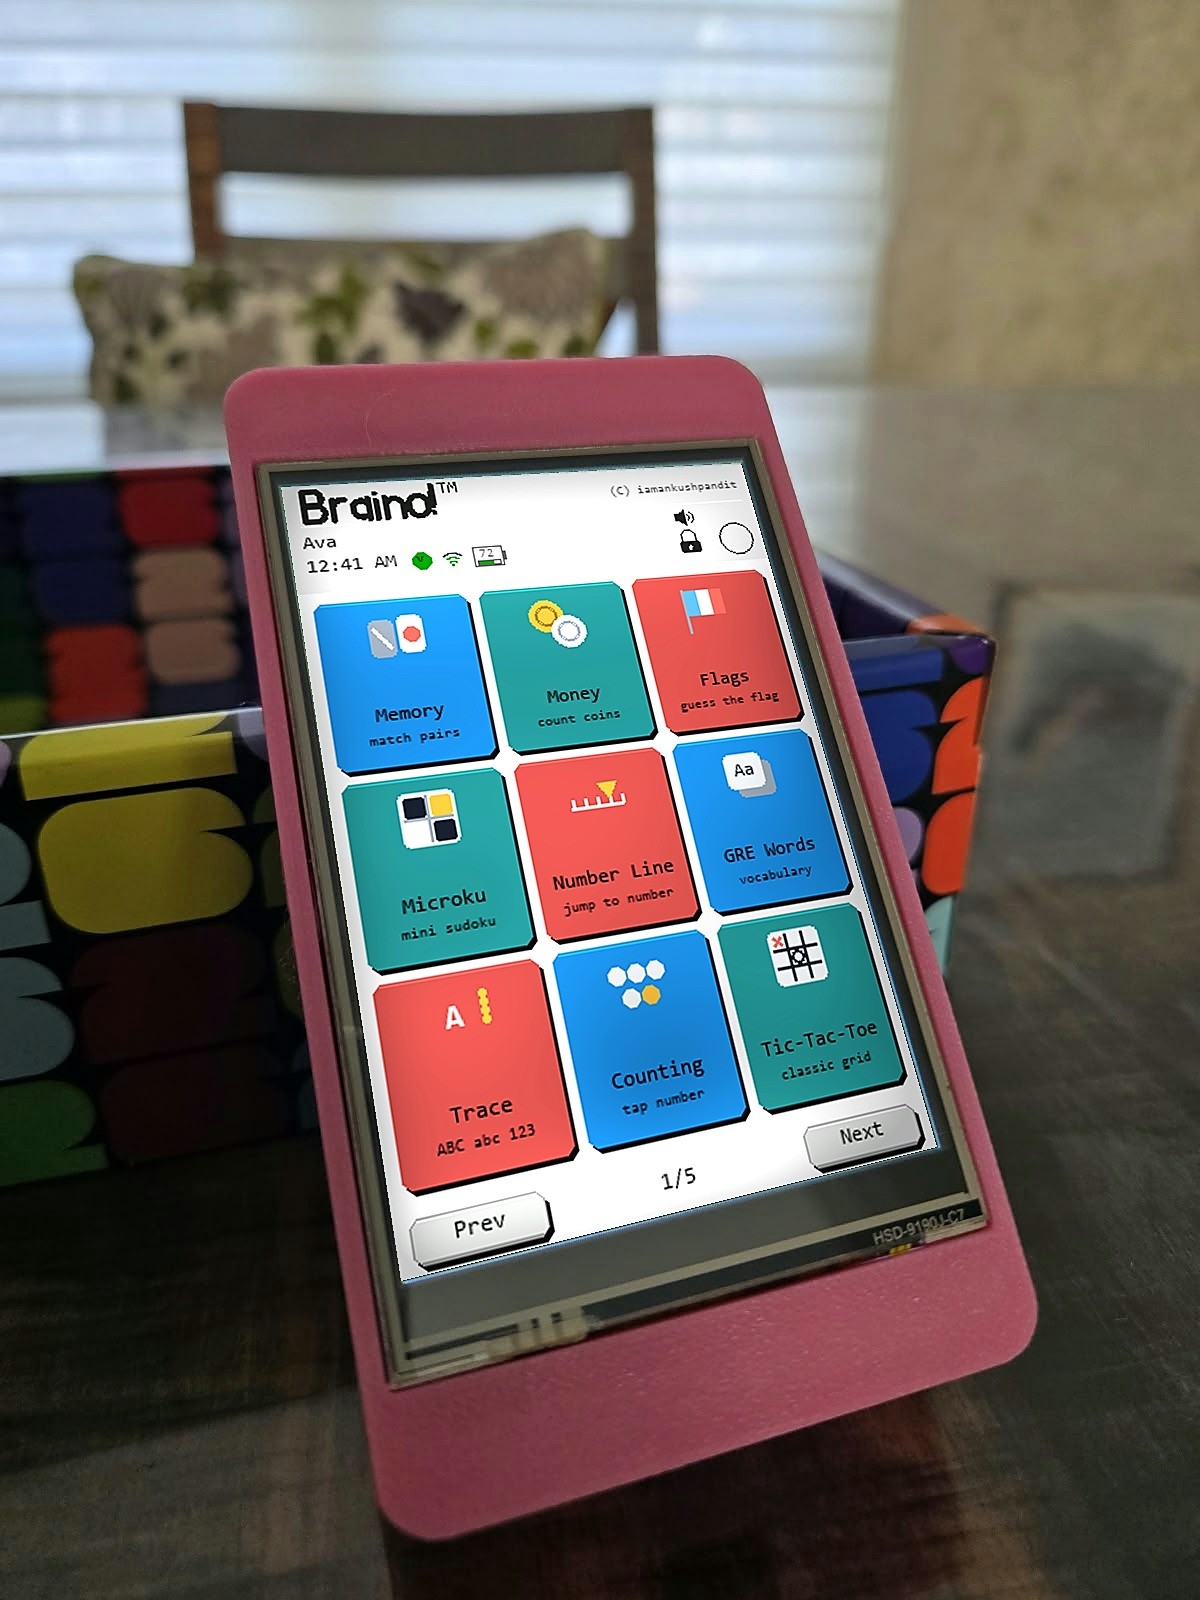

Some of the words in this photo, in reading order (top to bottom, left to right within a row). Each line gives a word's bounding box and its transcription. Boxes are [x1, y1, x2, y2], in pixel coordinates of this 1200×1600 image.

[610, 484, 630, 498] (C)
[637, 480, 738, 494] iamankushpandit
[303, 537, 337, 550] Ava
[479, 548, 495, 558] 72
[306, 557, 364, 574] 12:41
[374, 555, 398, 569] AM
[700, 671, 750, 687] Flags
[547, 687, 601, 704] Money
[680, 698, 716, 713] guess
[722, 695, 745, 706] the
[750, 691, 780, 703] flag
[375, 703, 445, 723] Memory
[537, 714, 576, 727] count
[583, 710, 621, 723] coins
[369, 733, 412, 747] match
[420, 727, 461, 741] pairs
[734, 763, 755, 778] Aa
[724, 845, 756, 863] GRE
[764, 837, 816, 857] Words
[552, 868, 620, 891] Number
[630, 858, 675, 880] Line
[739, 865, 812, 885] vocabulary
[401, 889, 487, 915] Microku
[564, 900, 596, 917] jump
[602, 897, 620, 908] to
[627, 887, 674, 904] number
[401, 925, 437, 942] mini
[445, 916, 497, 934] sudoku
[445, 1005, 465, 1030] A
[761, 1021, 878, 1057] Tic-Tac-Toe
[611, 1058, 705, 1090] Counting
[781, 1059, 835, 1081] classic
[842, 1050, 872, 1070] grid
[450, 1098, 513, 1124] Trace
[622, 1102, 649, 1116] tap
[656, 1088, 705, 1109] number
[436, 1138, 465, 1157] ABC
[474, 1133, 500, 1149] abc
[510, 1123, 536, 1140] 123
[841, 1121, 884, 1144] Next
[662, 1167, 697, 1190] 1/5
[454, 1210, 506, 1238] Prev
